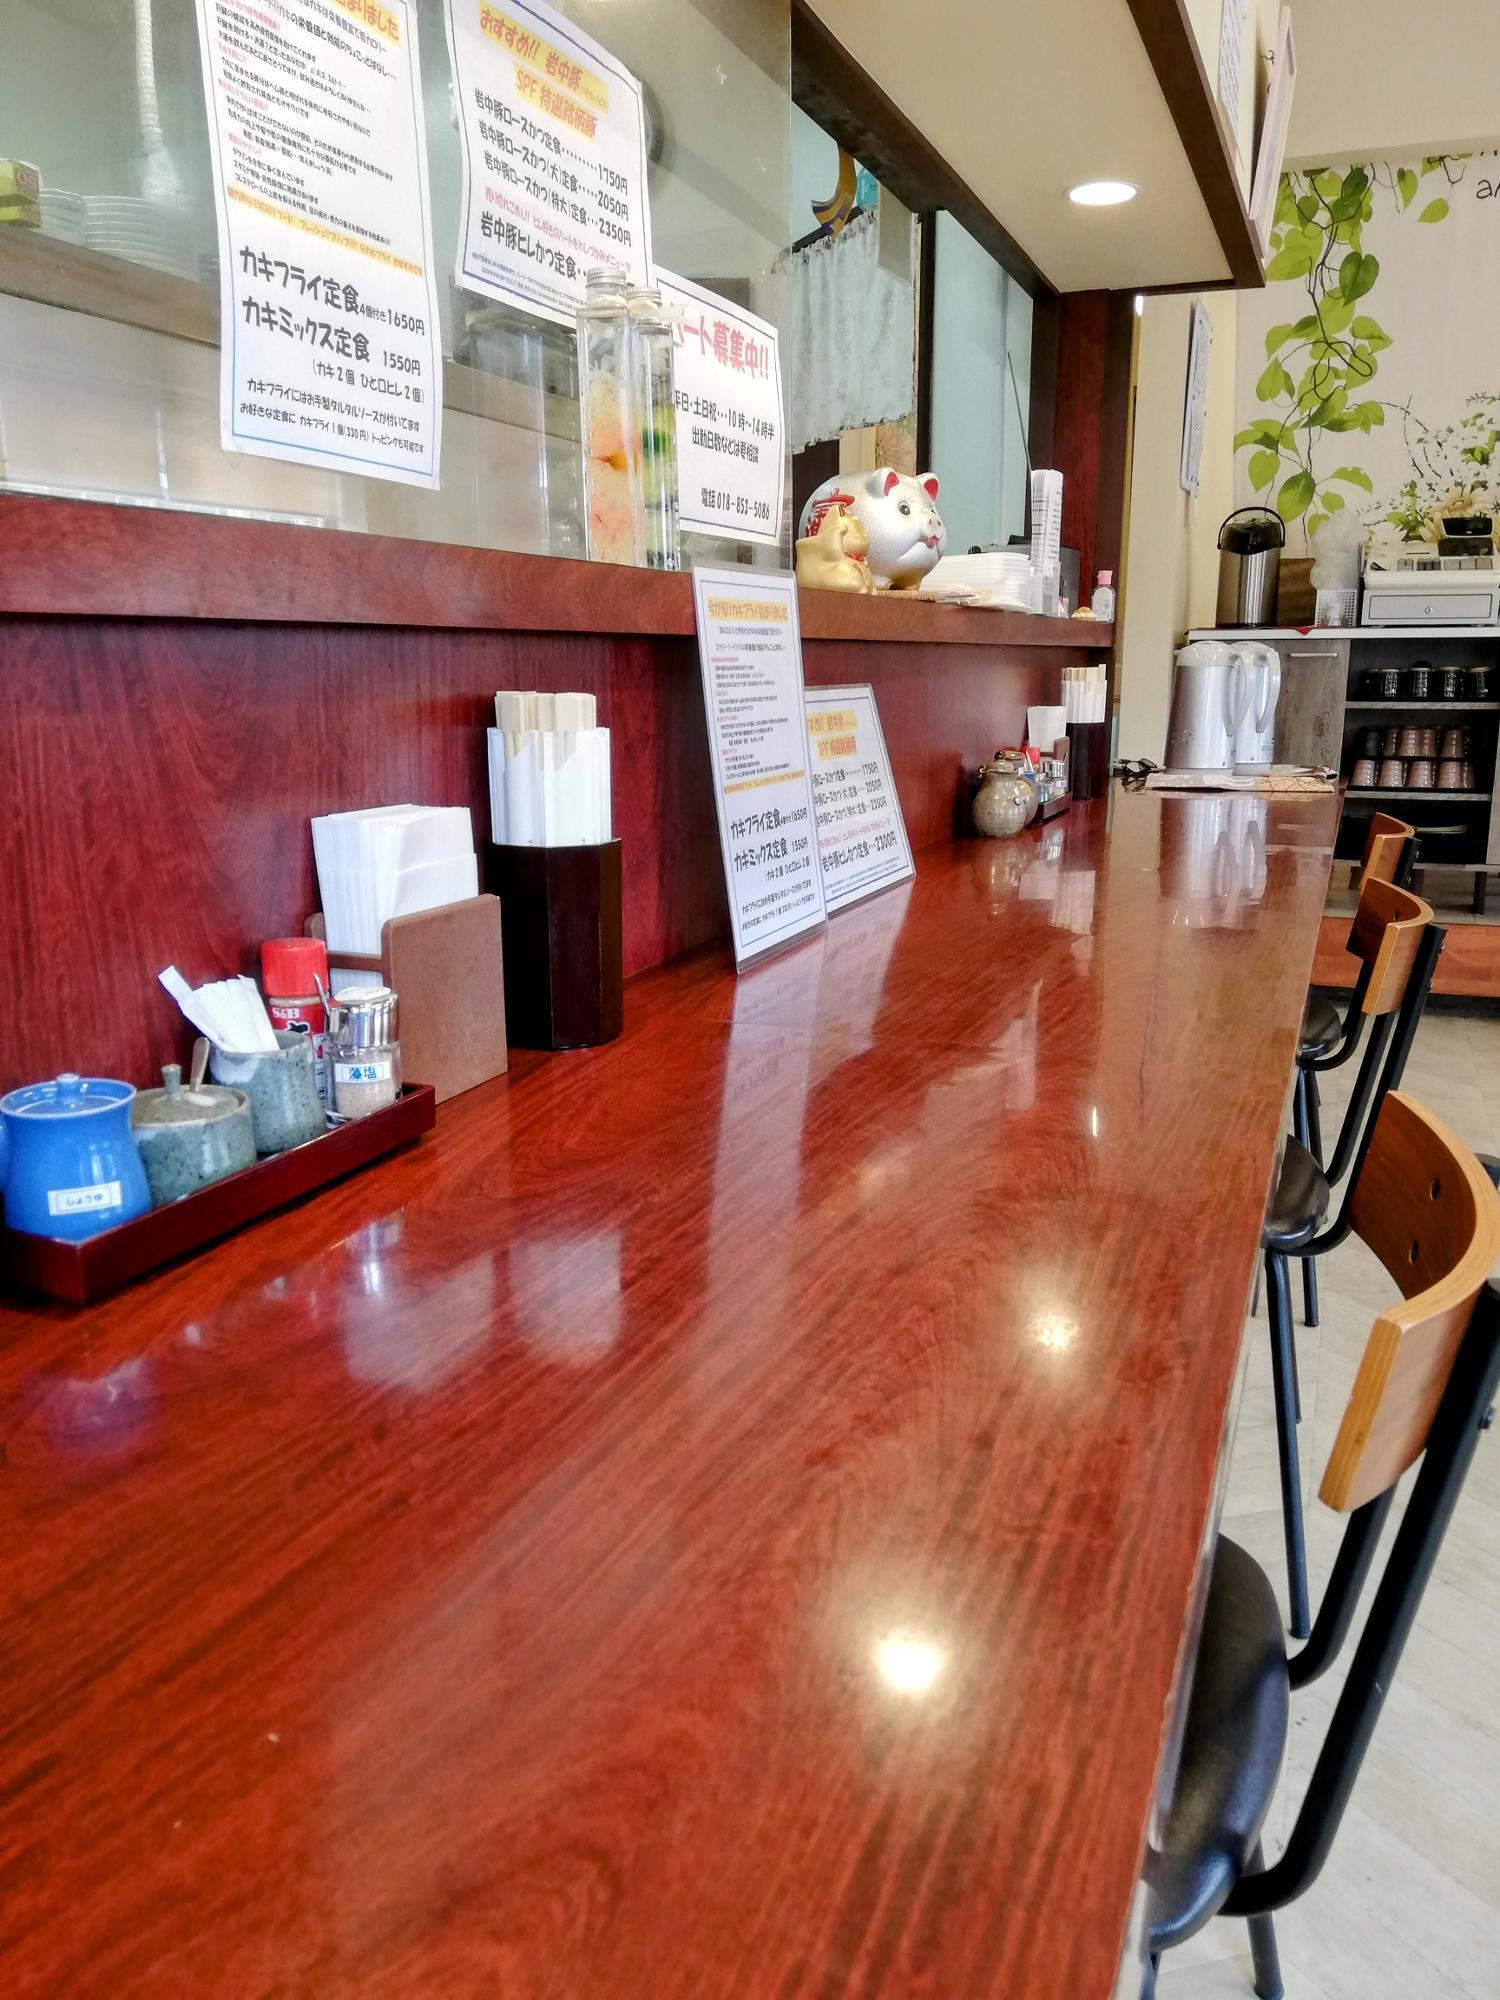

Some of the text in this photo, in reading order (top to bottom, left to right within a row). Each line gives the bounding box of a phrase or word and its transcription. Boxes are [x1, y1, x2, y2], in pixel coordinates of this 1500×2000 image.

[480, 8, 584, 90] おすすめ!! 岩中豚
[516, 71, 538, 99] SPF
[539, 85, 598, 137] 特選銘柄豚
[242, 296, 421, 377] カキミックス定食 1550円
[240, 402, 296, 424] お好きな定食に
[371, 433, 424, 454] トッピングも可能です
[247, 378, 420, 433] カキフライにはお手製タルタルソースが付いてます
[691, 426, 760, 464] 出勤日数などは要相談
[734, 837, 788, 873] カキミックス定食
[272, 1008, 301, 1019] S&B
[66, 1193, 103, 1206] しょうゆ
